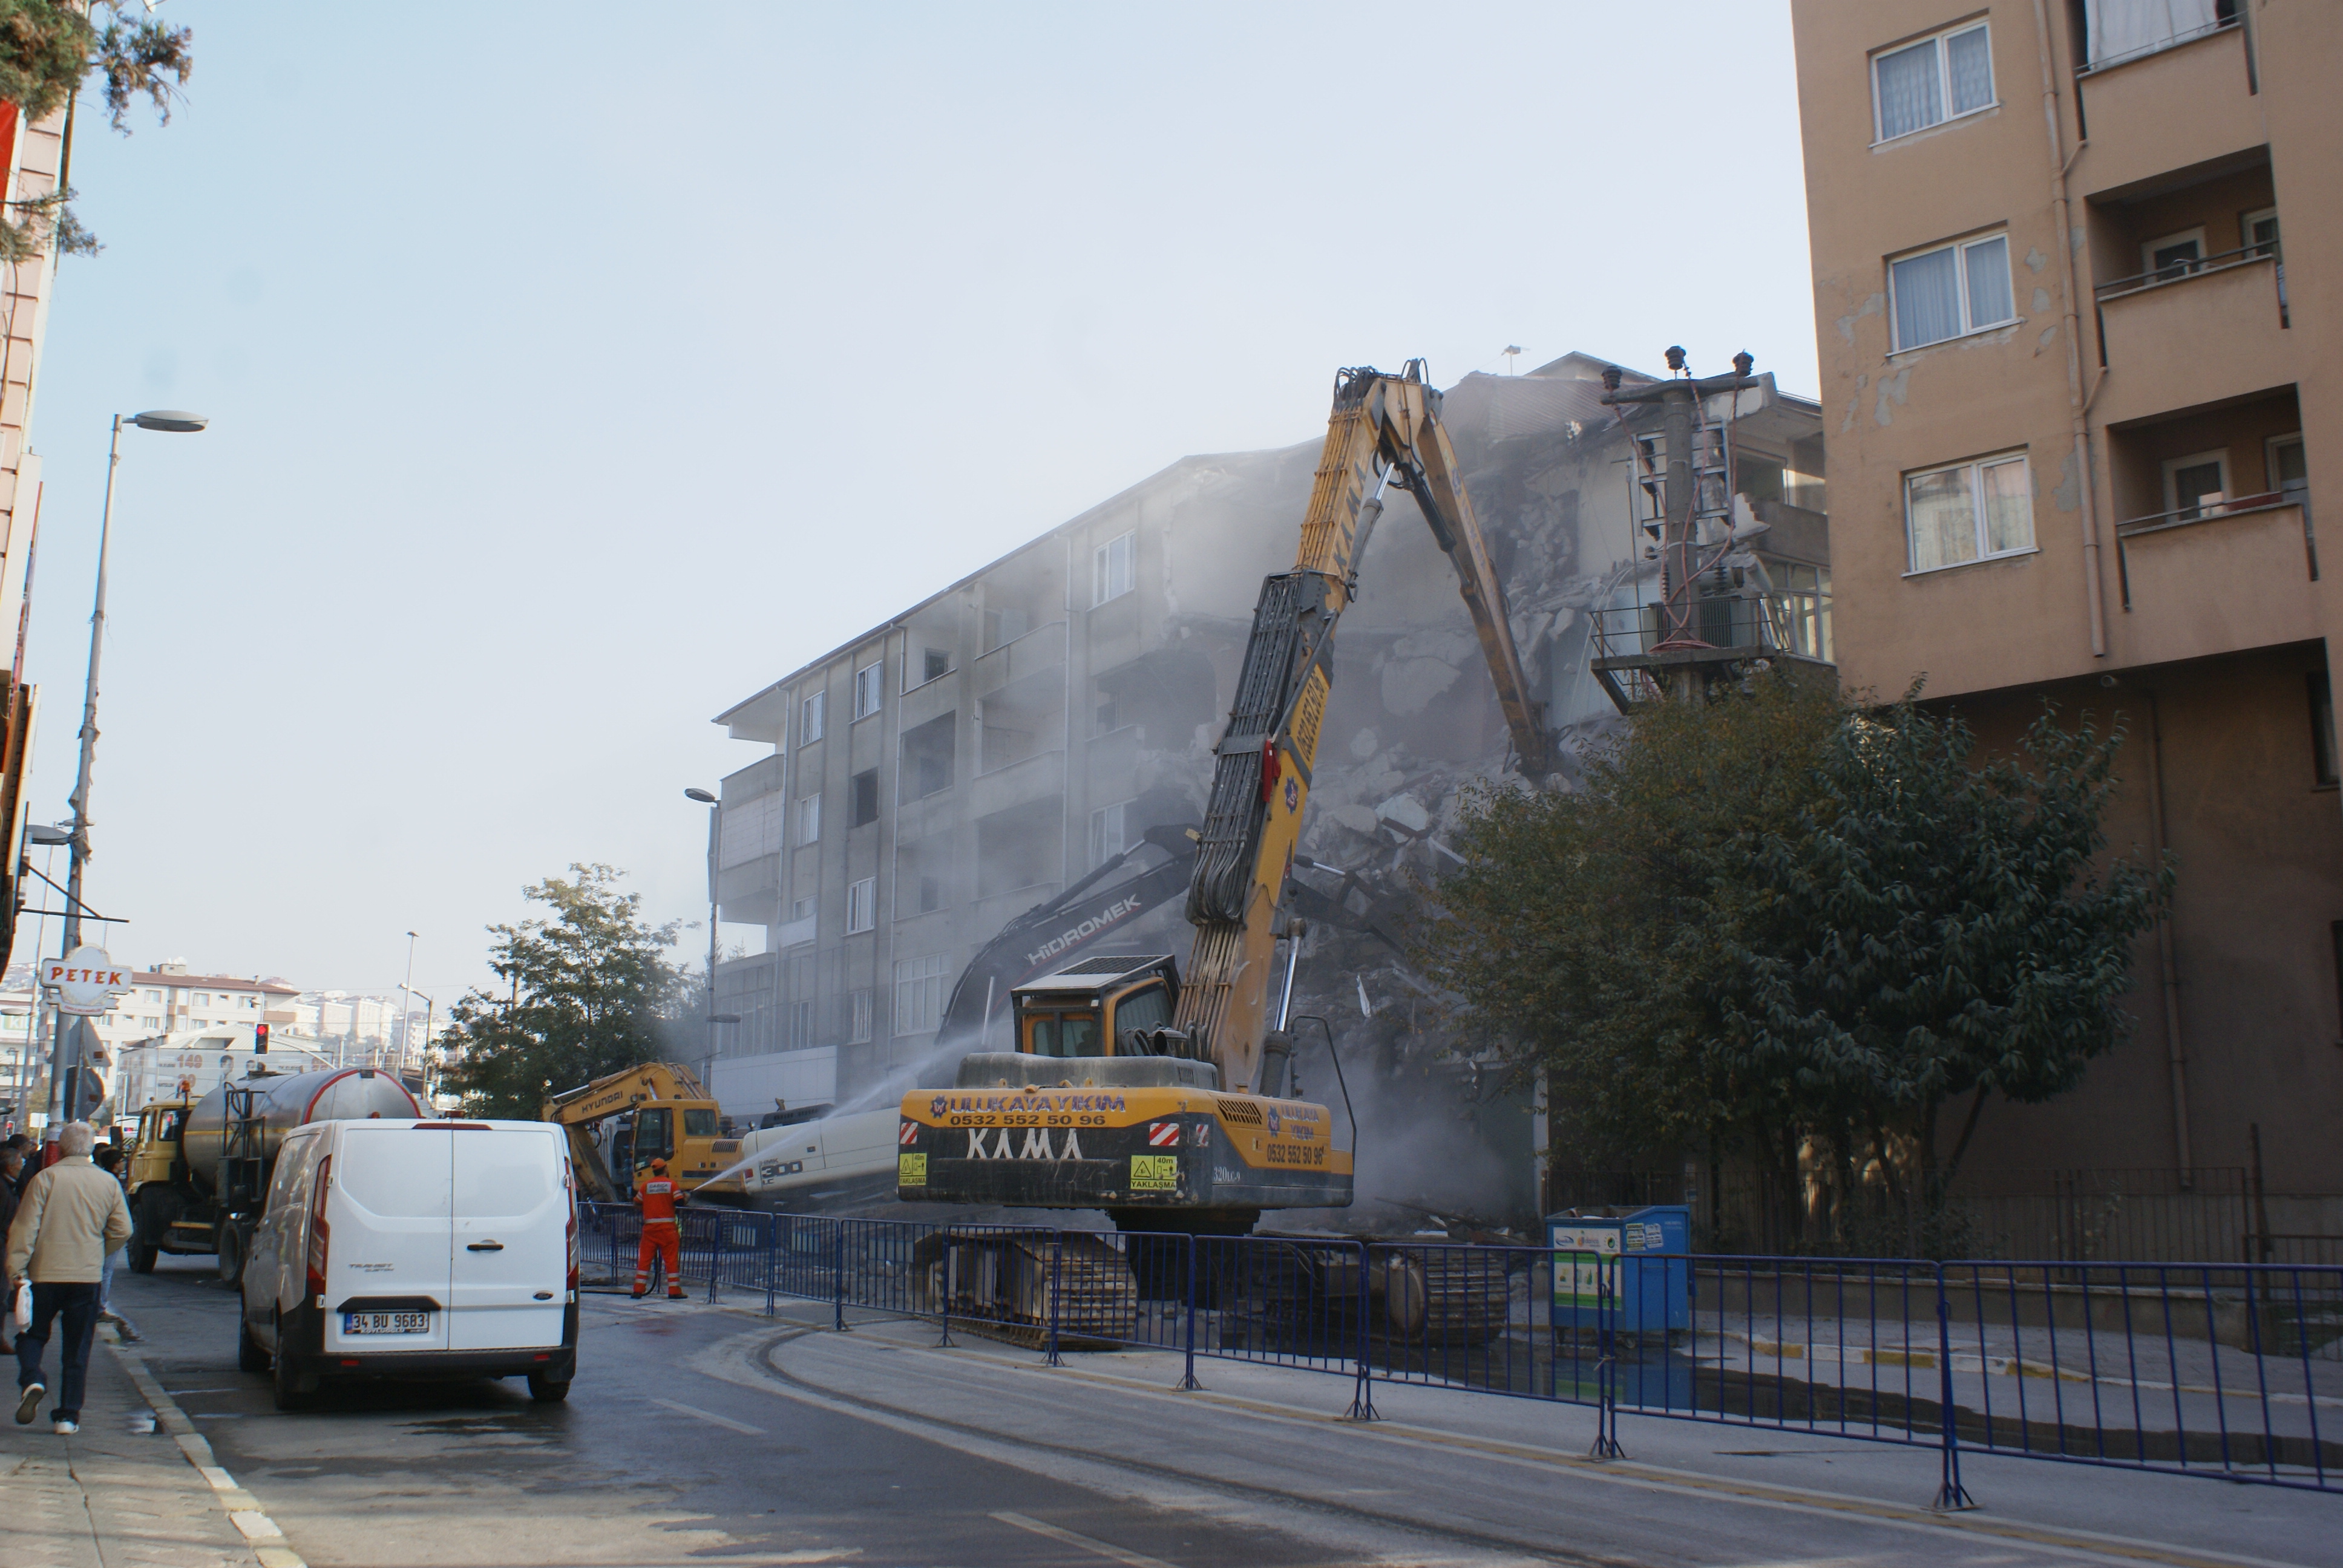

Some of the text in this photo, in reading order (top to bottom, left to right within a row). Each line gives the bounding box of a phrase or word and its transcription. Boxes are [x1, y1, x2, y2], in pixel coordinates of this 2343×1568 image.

[51, 967, 123, 985] PETEK
[177, 1054, 203, 1068] 149
[582, 1091, 623, 1113] HYUNDAI
[950, 1095, 1126, 1113] ULUKAYA YIKIM
[950, 1116, 1106, 1125] 0532 552 50 96
[966, 1128, 1083, 1160] KAMA
[1267, 1143, 1323, 1165] 0532 552 50 96
[761, 1160, 804, 1178] 300
[353, 1315, 369, 1328] 34
[373, 1315, 389, 1328] BU
